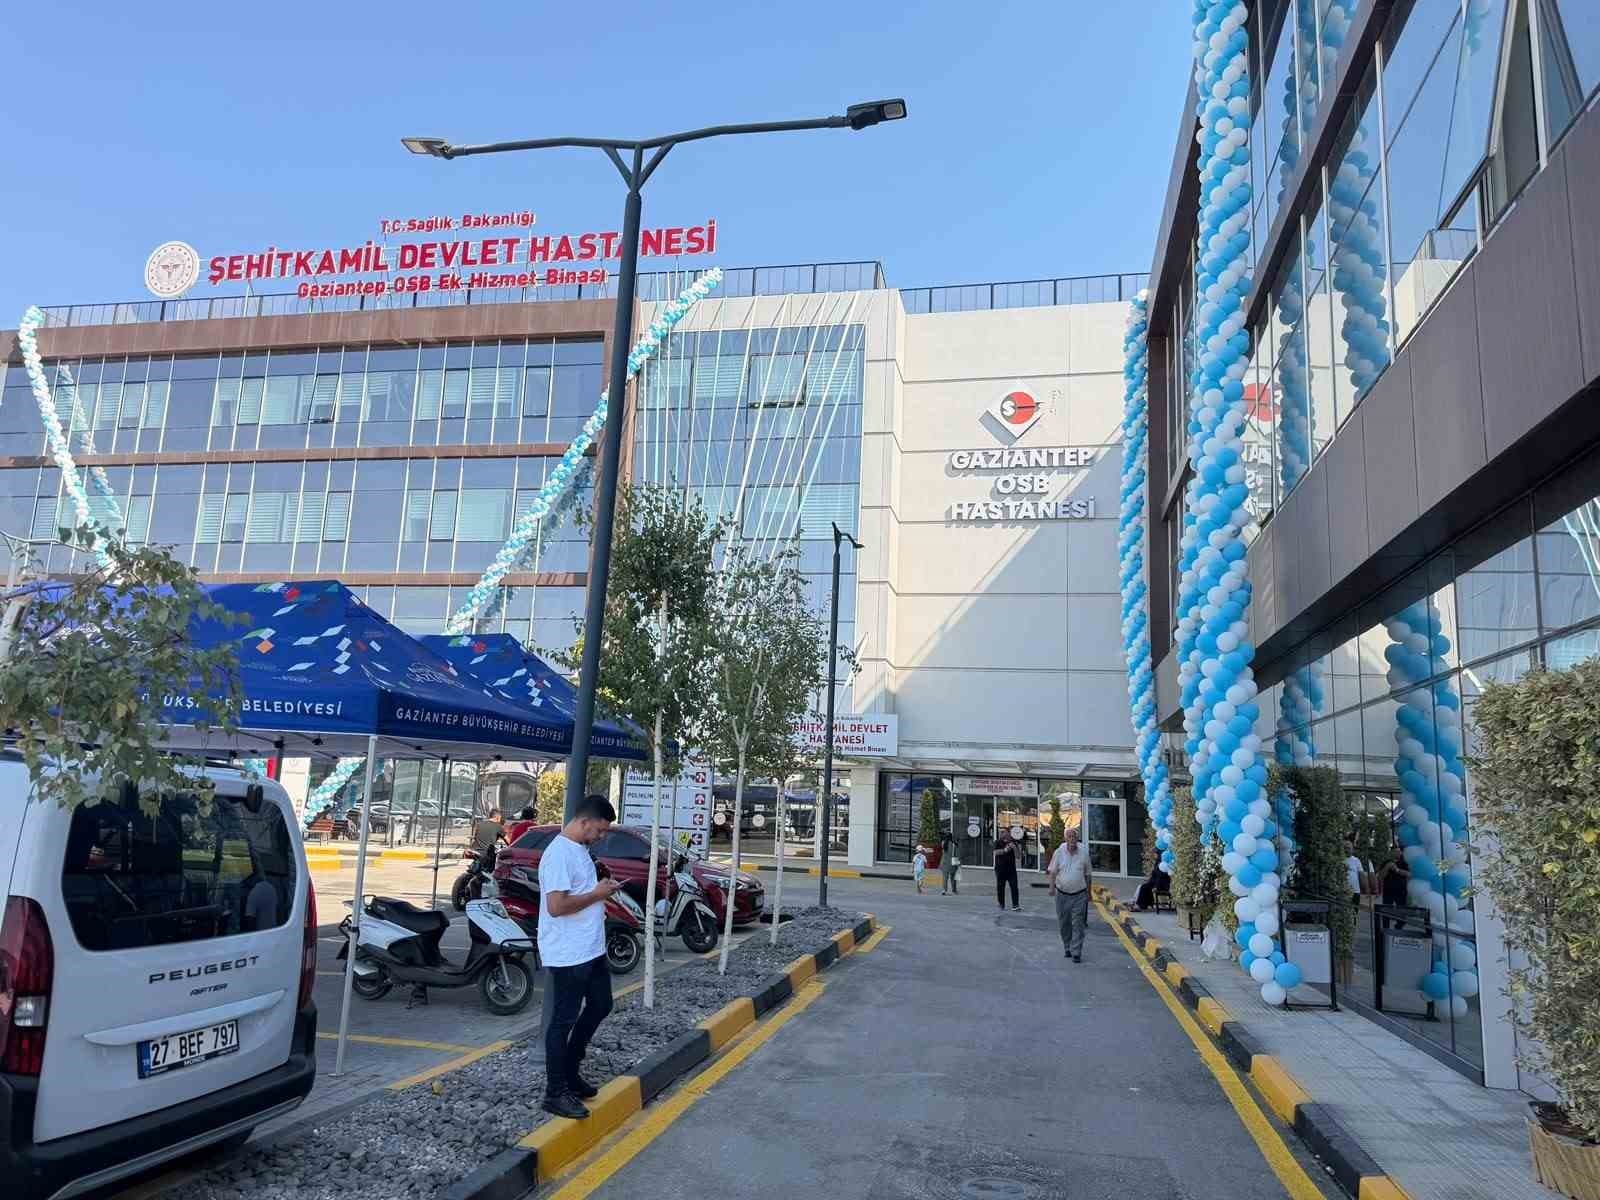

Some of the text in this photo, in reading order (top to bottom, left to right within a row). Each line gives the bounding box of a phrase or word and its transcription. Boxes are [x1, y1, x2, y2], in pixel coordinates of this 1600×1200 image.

[462, 210, 535, 228] Bakanlığı
[208, 241, 389, 285] ŞEHİTKAMİL
[400, 238, 520, 270] DEVLET
[298, 268, 608, 299] Gaziantep OSB Ek Hizmet Binası
[996, 475, 1050, 494] OSB
[951, 496, 1096, 520] HASTANESİ
[242, 699, 342, 716] BELEDİYESİ
[396, 707, 565, 742] GAZİANTEP BÜYÜKŞEHİR BELEDİYESİ
[850, 723, 889, 734] DEVLET
[809, 733, 865, 744] HASANESİ
[149, 955, 259, 984] PEUGEOT
[151, 1041, 169, 1067] 27
[179, 1031, 204, 1058] BEF
[213, 1023, 235, 1049] 797
